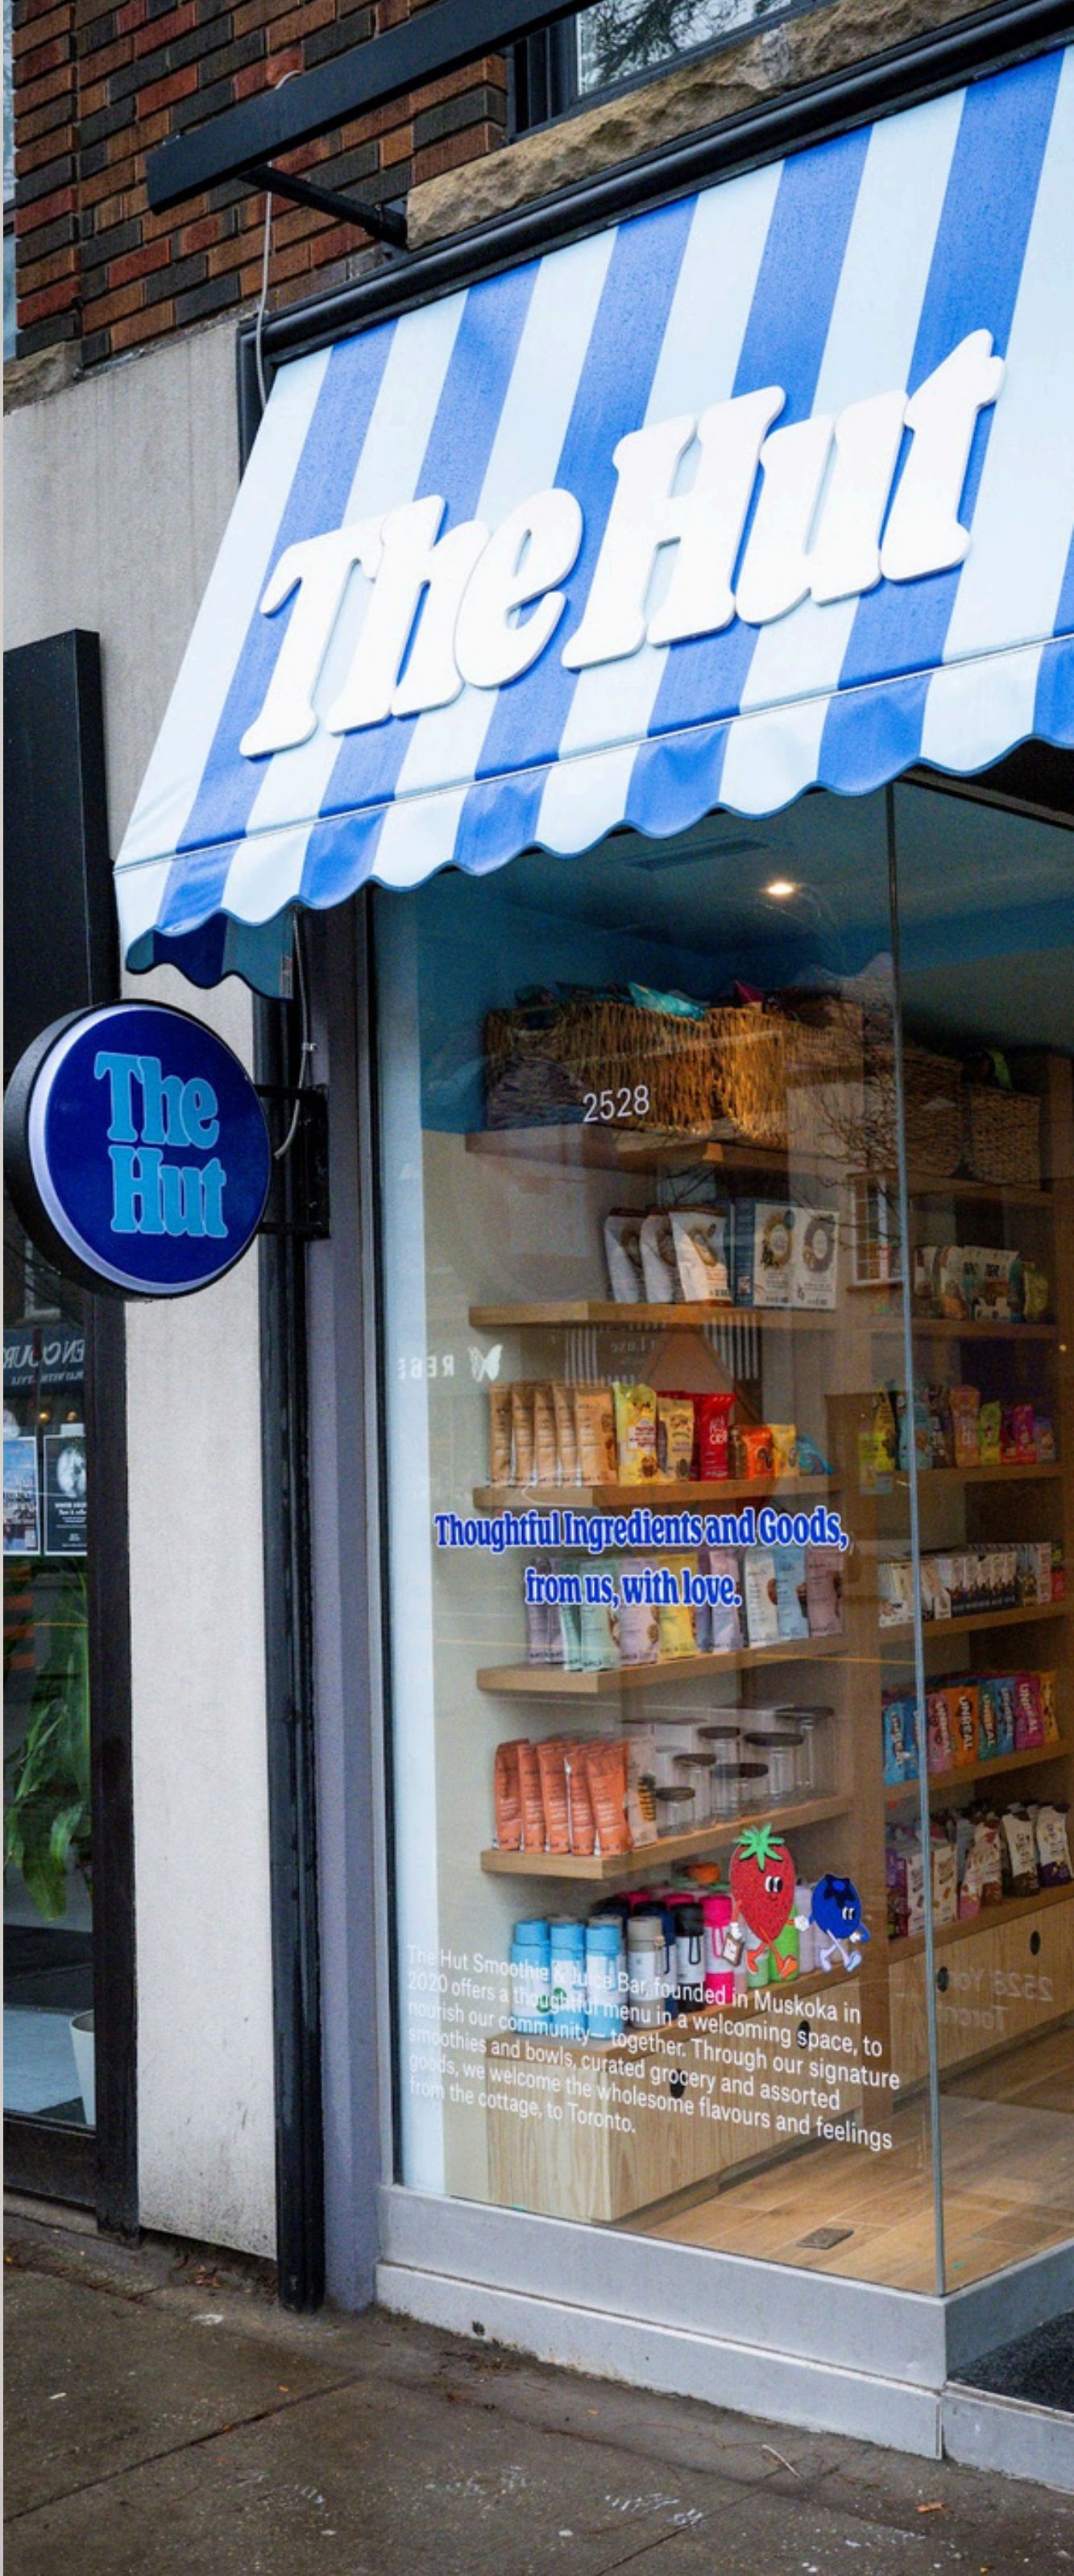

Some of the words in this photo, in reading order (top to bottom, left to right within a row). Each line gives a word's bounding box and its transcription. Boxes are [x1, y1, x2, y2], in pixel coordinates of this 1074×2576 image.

[239, 487, 583, 758] The
[562, 328, 1006, 671] Hut
[94, 1051, 219, 1149] The
[582, 1084, 650, 1124] 2528
[108, 1146, 228, 1238] Hut
[433, 1509, 562, 1554] Thoughtful
[562, 1508, 703, 1554] Ingredients
[706, 1506, 756, 1546] and
[758, 1505, 849, 1552] Goods,
[525, 1566, 582, 1606] from
[584, 1574, 620, 1610] us,
[621, 1567, 680, 1606] with
[681, 1567, 742, 1606] love.
[408, 1944, 435, 1965] The
[441, 1948, 468, 1971] Hut
[474, 1953, 550, 1981] Smoothie
[618, 1972, 650, 1997] Bar,
[654, 1977, 726, 2006] founded
[732, 1987, 748, 2009] in
[754, 1990, 838, 2022] Muskoka
[844, 2001, 860, 2025] in
[409, 1972, 448, 1993] 2020
[452, 1977, 496, 2001] offers
[499, 1987, 509, 2003] a
[514, 1986, 598, 2015] thoughtful
[603, 2002, 652, 2024] menu
[657, 2006, 672, 2026] in
[678, 2013, 687, 2030] a
[693, 2014, 791, 2048] welcoming
[797, 2029, 859, 2056] space,
[864, 2035, 883, 2058] to
[409, 2001, 464, 2023] nourish
[469, 2010, 495, 2028] our
[611, 2030, 686, 2057] together.
[690, 2038, 767, 2072] Through
[773, 2055, 804, 2076] our
[809, 2057, 901, 2091] signature
[409, 2027, 487, 2053] smoothies
[491, 2039, 520, 2059] and
[525, 2040, 577, 2069] bowls,
[581, 2054, 645, 2079] curated
[650, 2065, 716, 2094] grocery
[721, 2076, 754, 2097] and
[760, 2081, 840, 2111] assorted
[409, 2054, 459, 2078] goods,
[463, 2063, 485, 2080] we
[489, 2065, 561, 2093] welcome
[565, 2075, 592, 2097] the
[598, 2080, 695, 2116] wholesome
[699, 2096, 771, 2129] flavours
[776, 2113, 810, 2134] and
[816, 2115, 893, 2152] feelings
[409, 2076, 445, 2100] from
[450, 2084, 475, 2105] the
[478, 2093, 543, 2119] cottage,
[547, 2101, 563, 2120] to
[567, 2102, 637, 2134] Toronto.
